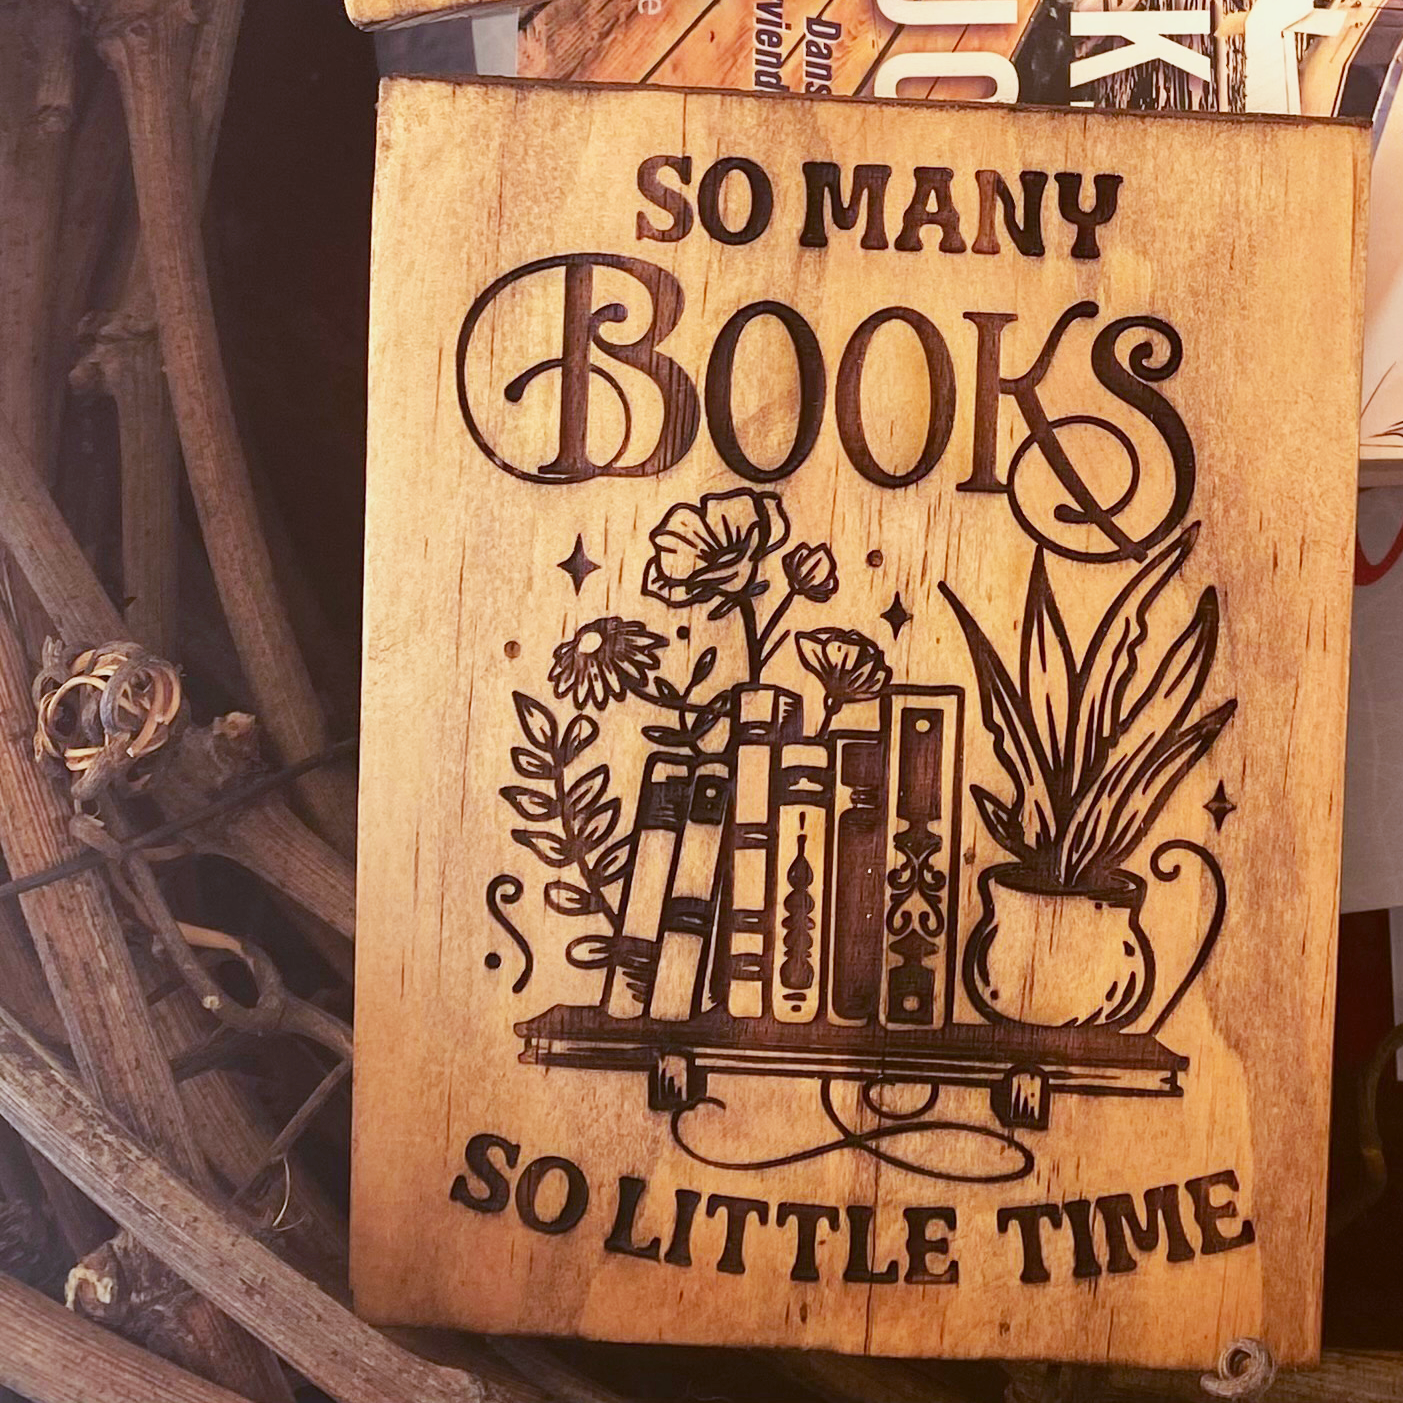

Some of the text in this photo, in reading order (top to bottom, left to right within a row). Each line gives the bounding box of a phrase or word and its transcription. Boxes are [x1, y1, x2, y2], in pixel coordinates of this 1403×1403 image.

[636, 155, 1124, 259] SO MANY
[456, 252, 1197, 565] BOOKS
[450, 1133, 1257, 1284] SO LITTLE TIME
